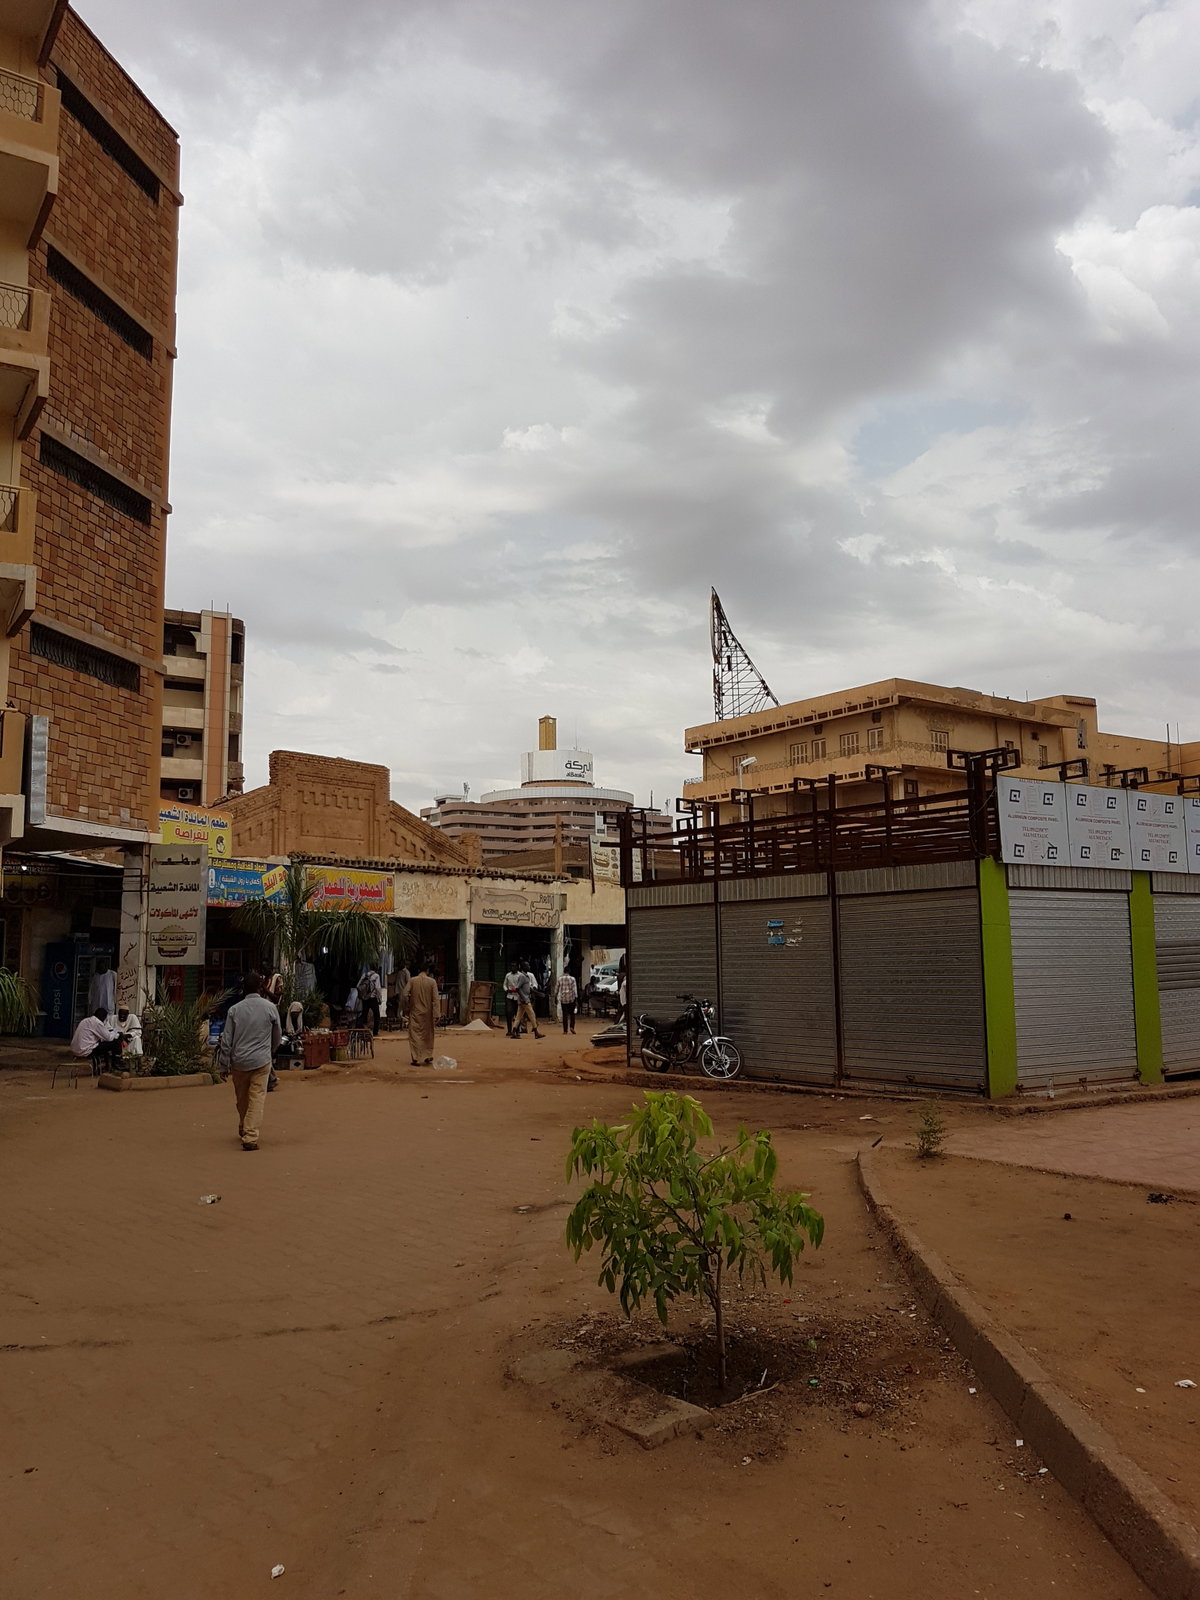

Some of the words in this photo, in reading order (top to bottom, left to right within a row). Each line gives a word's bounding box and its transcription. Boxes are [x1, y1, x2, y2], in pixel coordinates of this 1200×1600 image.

[564, 760, 593, 774] البركة
[185, 810, 210, 826] المائدة
[211, 817, 228, 831] مطعم
[174, 825, 209, 842] للقراصة
[151, 853, 200, 869] مطعم
[150, 881, 179, 895] الشعبية
[179, 882, 200, 893] المائدة
[347, 876, 385, 902] الجمهورية
[52, 989, 62, 1020] pepsi
